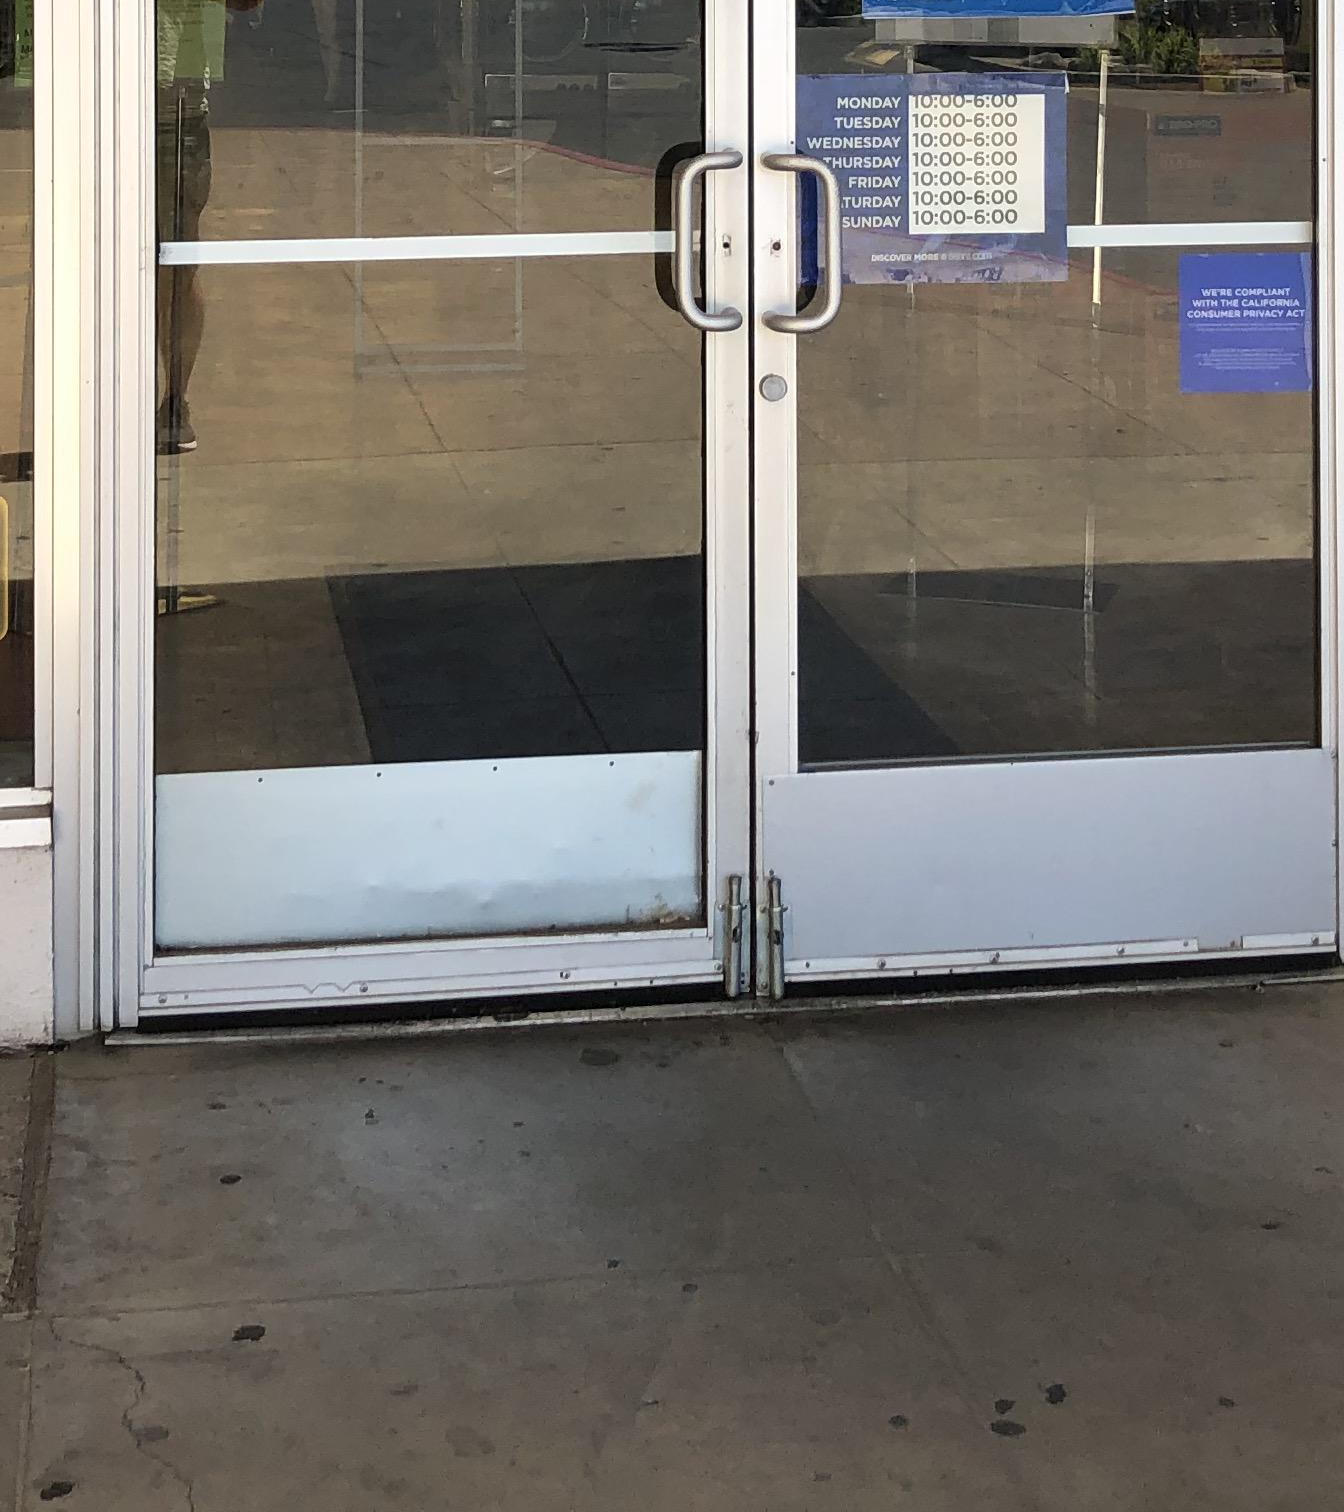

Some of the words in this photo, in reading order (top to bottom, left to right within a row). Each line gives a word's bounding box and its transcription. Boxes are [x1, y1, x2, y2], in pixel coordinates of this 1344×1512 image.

[837, 97, 902, 109] MONDAY
[912, 94, 1018, 109] 10:00-6:00
[834, 116, 902, 129] TUESDAY
[912, 113, 1018, 128] 10:00-6:00
[807, 136, 902, 149] WEDNESDAY
[912, 132, 1018, 148] 10:00-6:00
[823, 156, 902, 169] THURSDAY
[912, 151, 1018, 167] 10:00-6:00
[849, 175, 902, 188] FRIDAY
[912, 171, 1018, 186] 10:00-6:00
[841, 196, 902, 209] TURDAY
[912, 190, 1018, 206] 10:00-6:00
[842, 215, 902, 229] SUNDAY
[912, 209, 1018, 226] 10:00-6:00
[871, 254, 912, 262] DISCOVER
[1201, 288, 1232, 297] WE'RE
[1235, 288, 1290, 296] COMPLIANT
[1192, 299, 1218, 307] WITH
[1220, 299, 1238, 307] THE
[1241, 299, 1300, 307] CALIFORNIA
[1187, 310, 1241, 318] CONSUMER
[1243, 309, 1283, 318] PRIVACY
[1285, 309, 1305, 317] ACT
